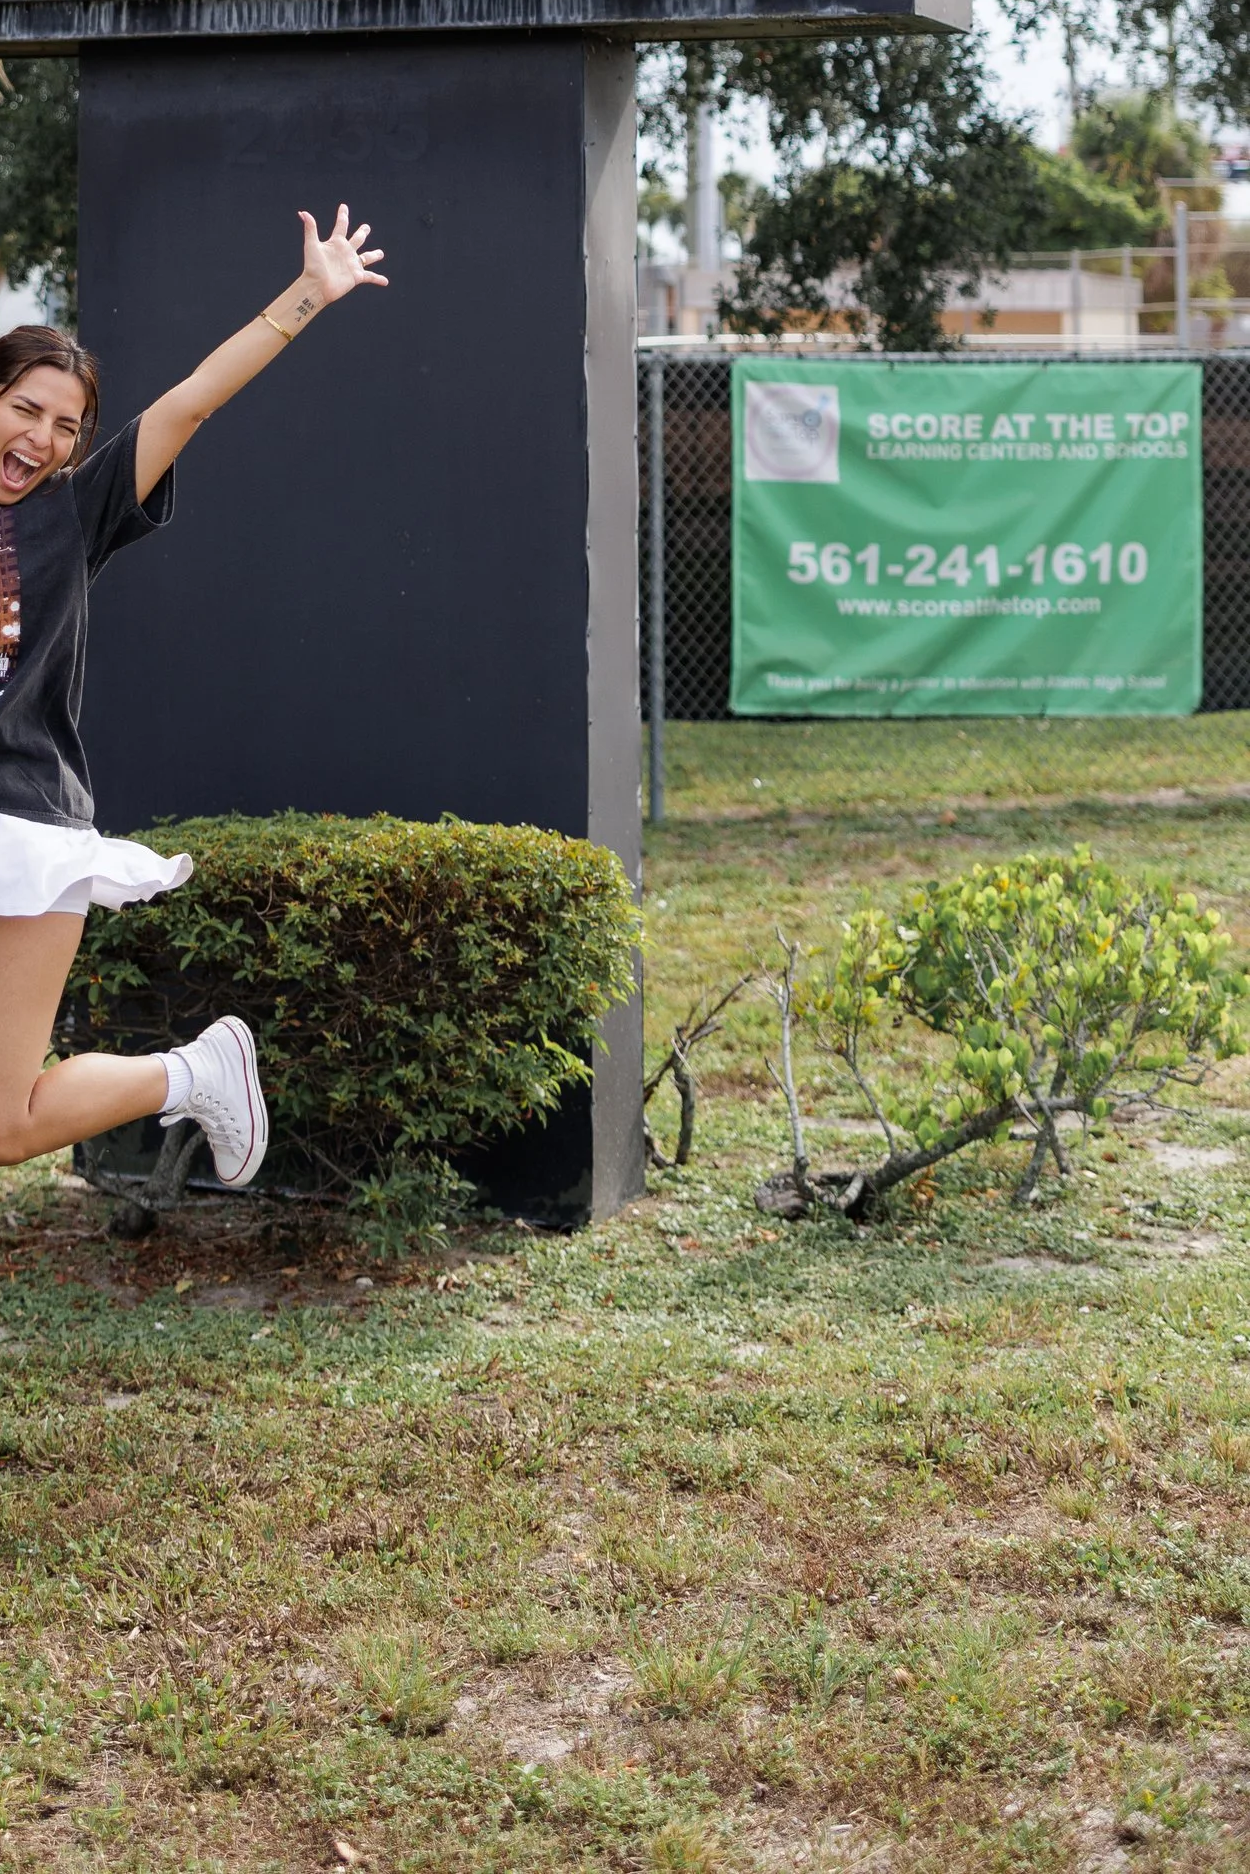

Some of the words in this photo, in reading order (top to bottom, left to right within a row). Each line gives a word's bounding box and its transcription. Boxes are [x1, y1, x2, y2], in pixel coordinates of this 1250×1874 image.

[867, 412, 983, 440] SCORE
[991, 413, 1036, 440] AT
[1045, 413, 1116, 440] THE
[1125, 411, 1189, 439] TOP
[866, 441, 963, 461] LEARNING
[966, 442, 1053, 461] CENTERS
[1056, 442, 1099, 461] AND
[1103, 440, 1189, 460] SCHOOLS
[787, 542, 1148, 587] 561-241-1610
[836, 596, 1102, 617] www.scoreatthetop.com
